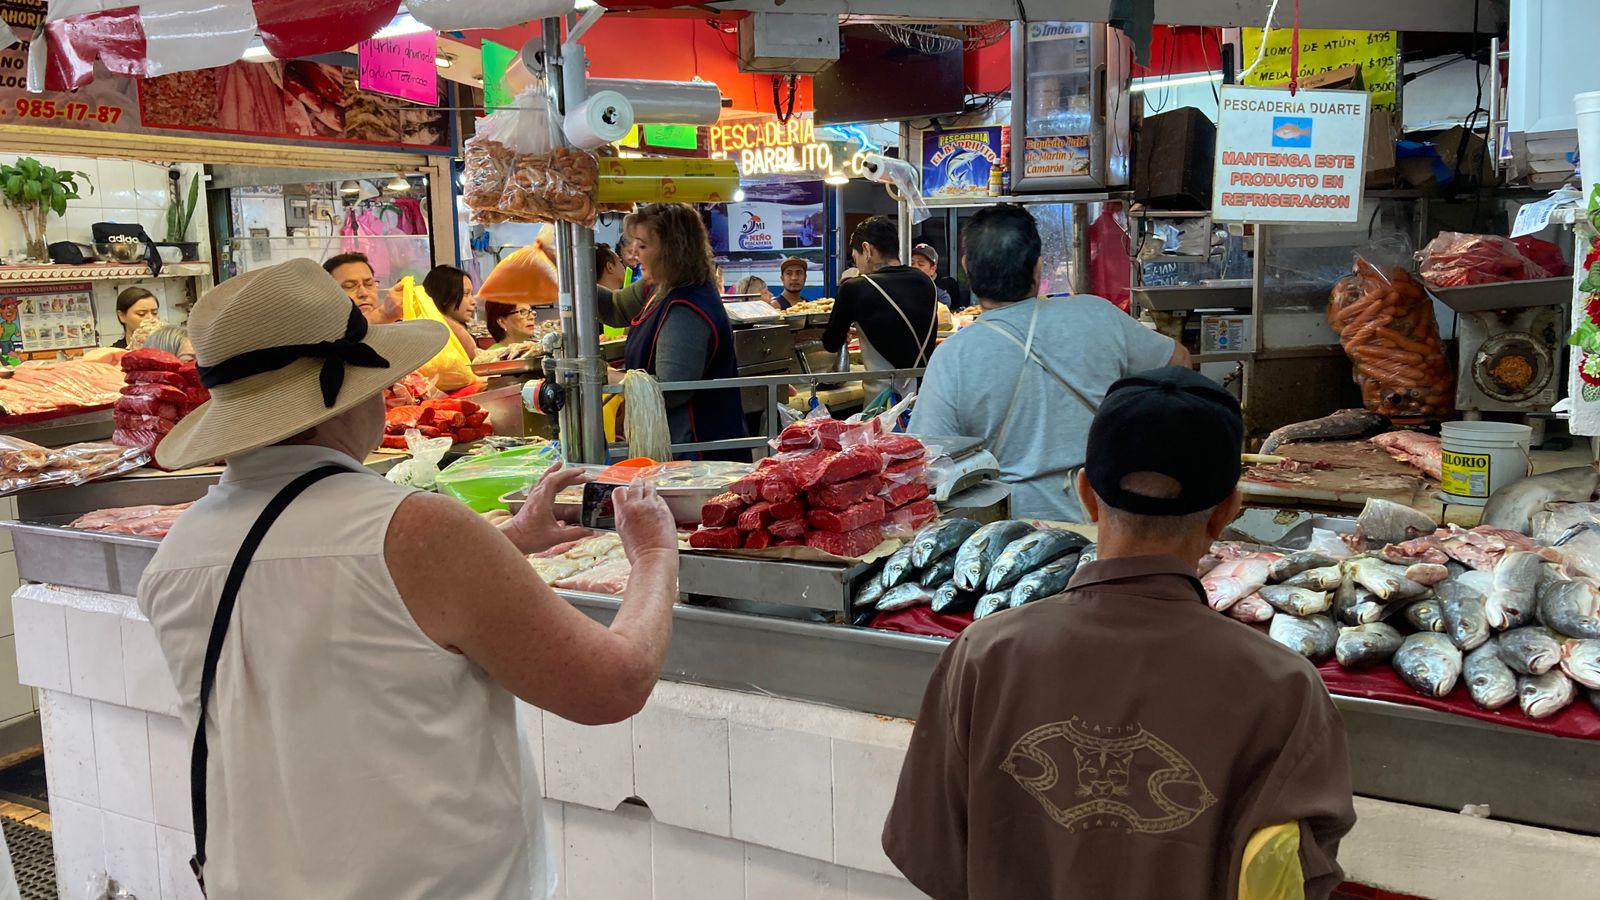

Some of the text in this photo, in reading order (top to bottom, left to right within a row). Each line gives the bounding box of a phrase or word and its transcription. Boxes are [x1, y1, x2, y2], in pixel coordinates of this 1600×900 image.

[1042, 24, 1083, 36] Imbera
[1303, 42, 1318, 52] DE
[1324, 36, 1356, 49] ATÚN
[1367, 32, 1391, 45] $195
[1259, 64, 1315, 81] MEDAÓN
[1368, 56, 1394, 69] $195
[16, 98, 122, 124] 985-17-87
[1224, 99, 1361, 115] PESCADERIA DUARTE
[710, 118, 816, 151] PESCADERIA
[939, 132, 989, 147] PESCADERIA
[742, 143, 829, 176] BARRILITO
[932, 153, 943, 165] EL
[943, 140, 996, 161] BARRILITO
[1222, 152, 1355, 168] MANTENGA ESTE
[1027, 163, 1064, 174] Camarón
[1230, 172, 1344, 188] PRODUCTO EN
[1222, 193, 1350, 208] REFRIGERACION
[749, 233, 772, 241] NIÑO
